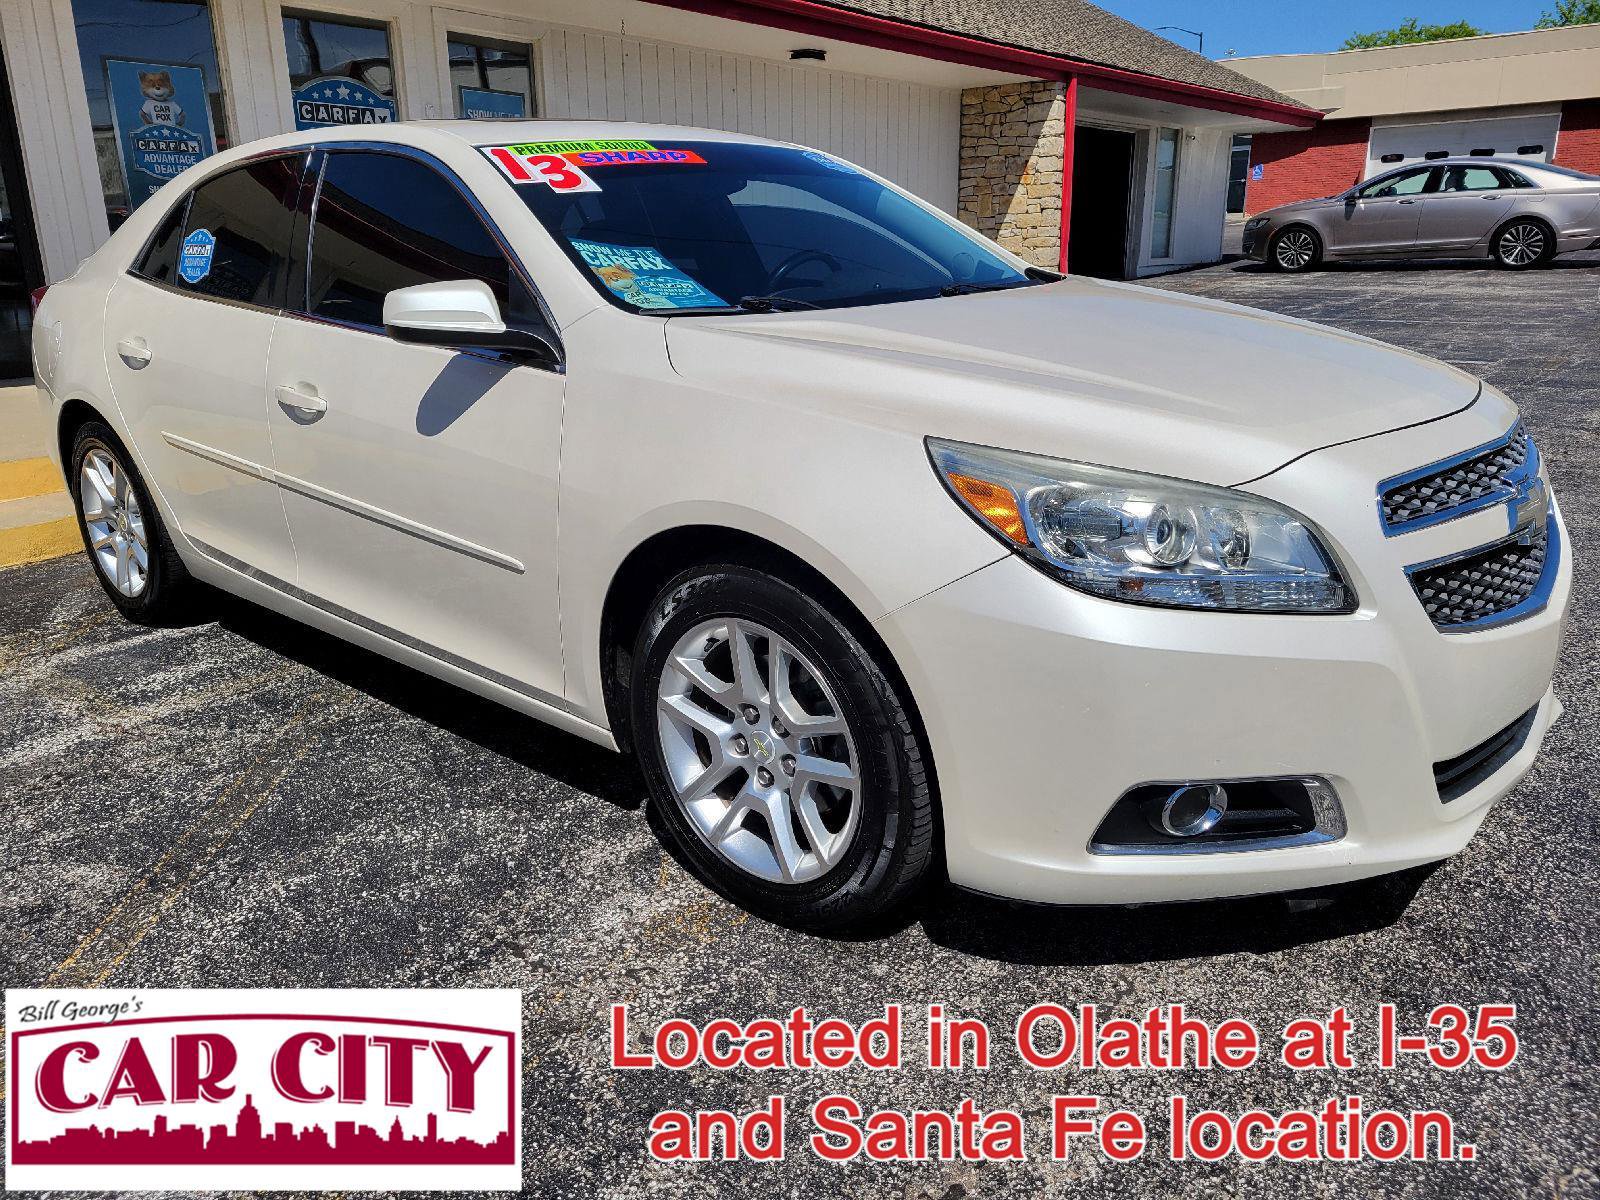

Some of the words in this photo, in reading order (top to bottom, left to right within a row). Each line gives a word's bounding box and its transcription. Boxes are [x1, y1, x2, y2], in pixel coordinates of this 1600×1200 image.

[153, 104, 170, 113] CAR
[155, 112, 171, 122] FOX
[138, 140, 199, 153] CARFAX
[513, 141, 594, 156] PREMIUM
[599, 140, 650, 151] SOUND
[143, 153, 196, 164] ADVANTAGE
[577, 150, 687, 164] SHARP
[491, 148, 582, 189] 13
[571, 241, 613, 255] SHOW
[580, 251, 673, 270] CARFAX
